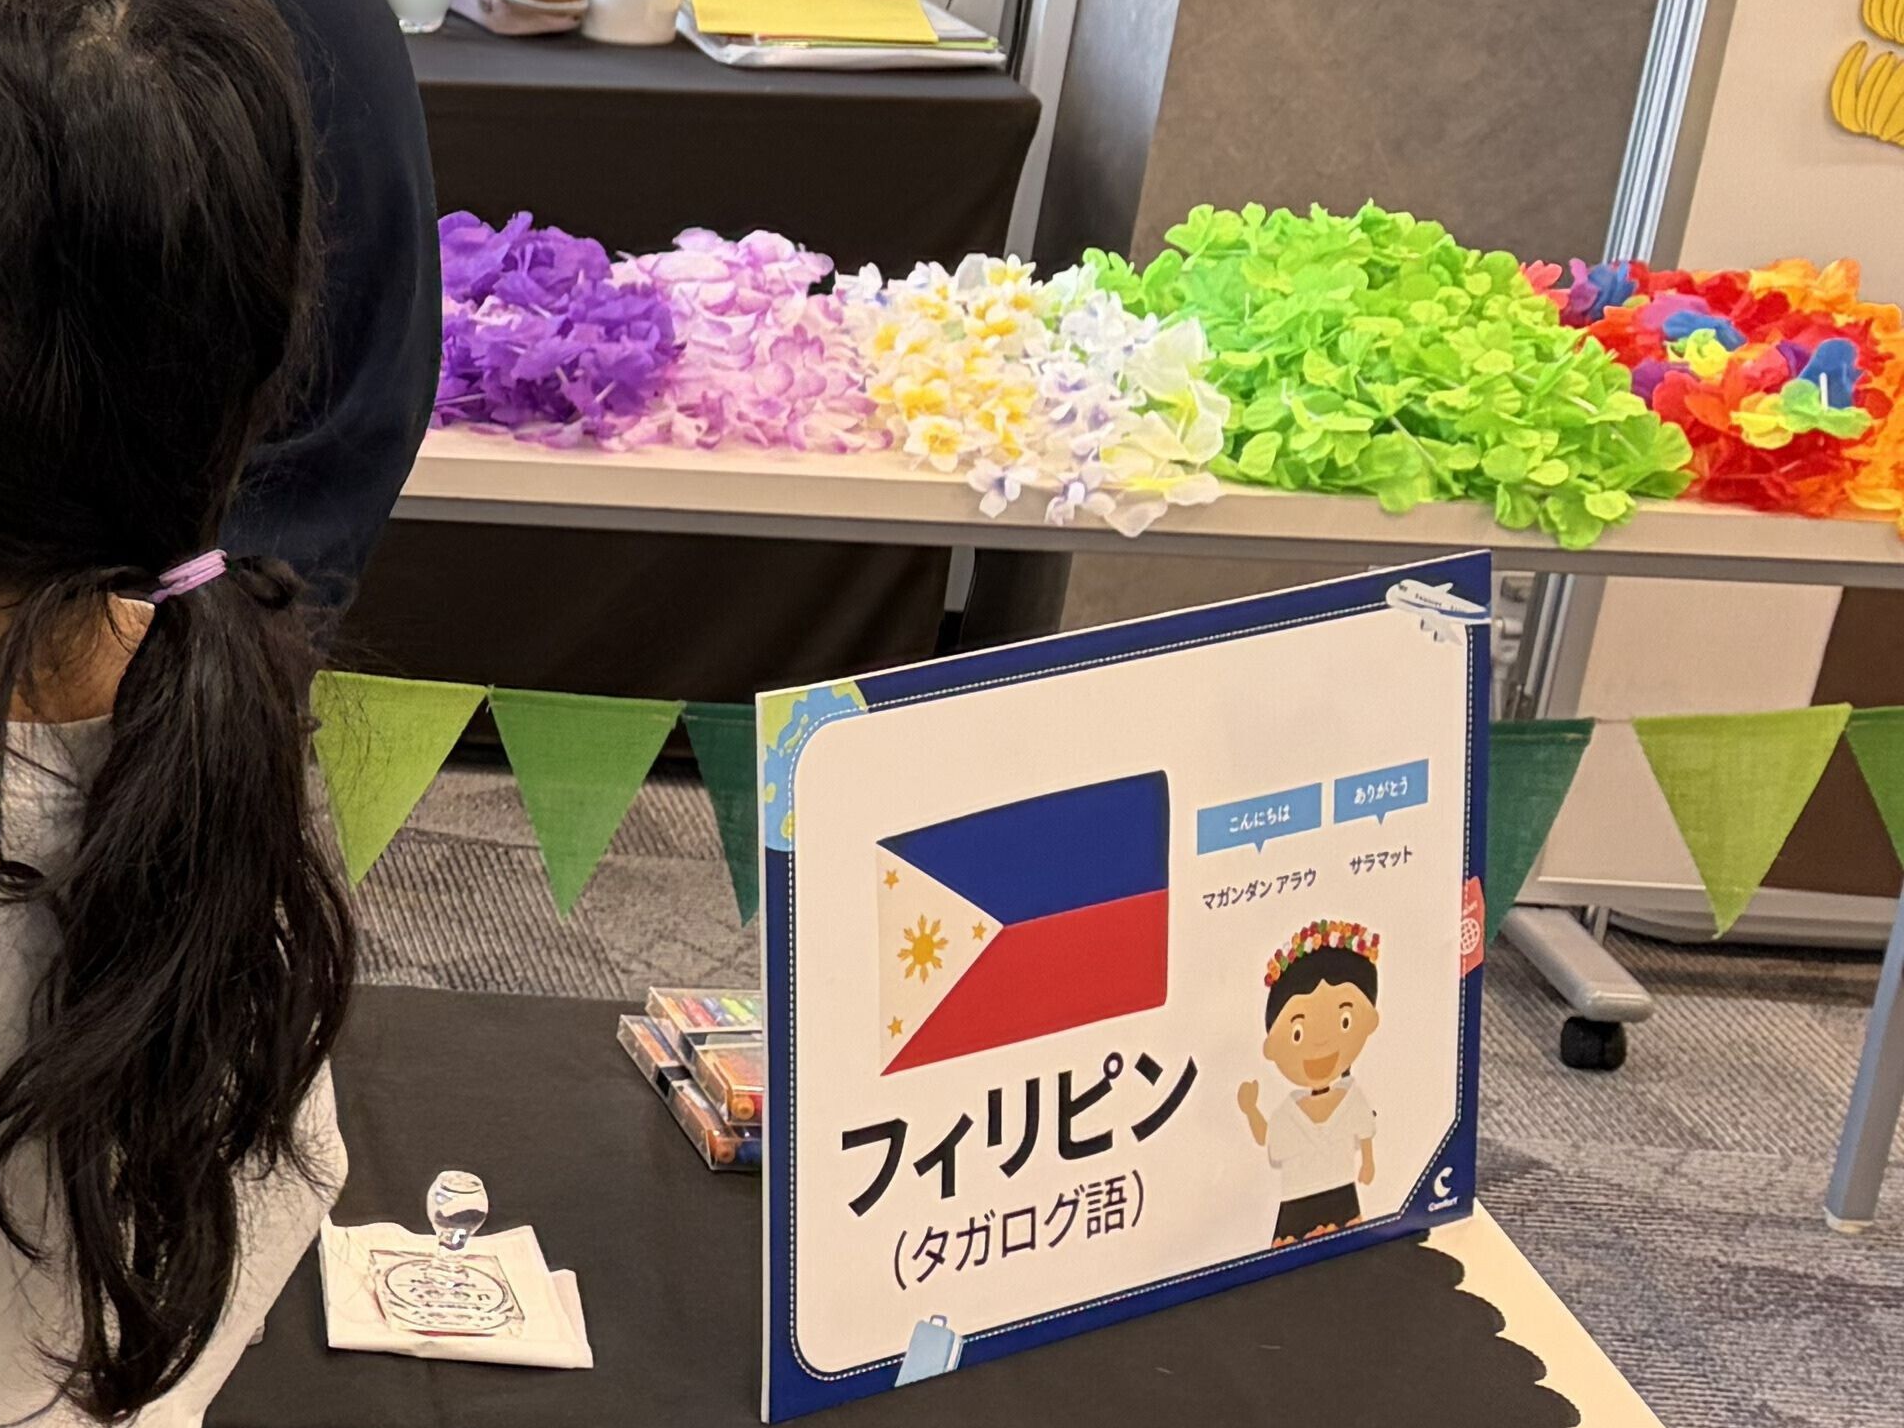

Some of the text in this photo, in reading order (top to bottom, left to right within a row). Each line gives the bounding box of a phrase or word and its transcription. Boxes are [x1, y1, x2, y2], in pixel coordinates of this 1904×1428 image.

[1352, 774, 1409, 805] ありがとう
[1228, 802, 1292, 835] こんにちは
[1348, 844, 1414, 876] サラマット
[840, 1050, 1199, 1219] フィリピン
[892, 1168, 1146, 1292] (タガログ語)
